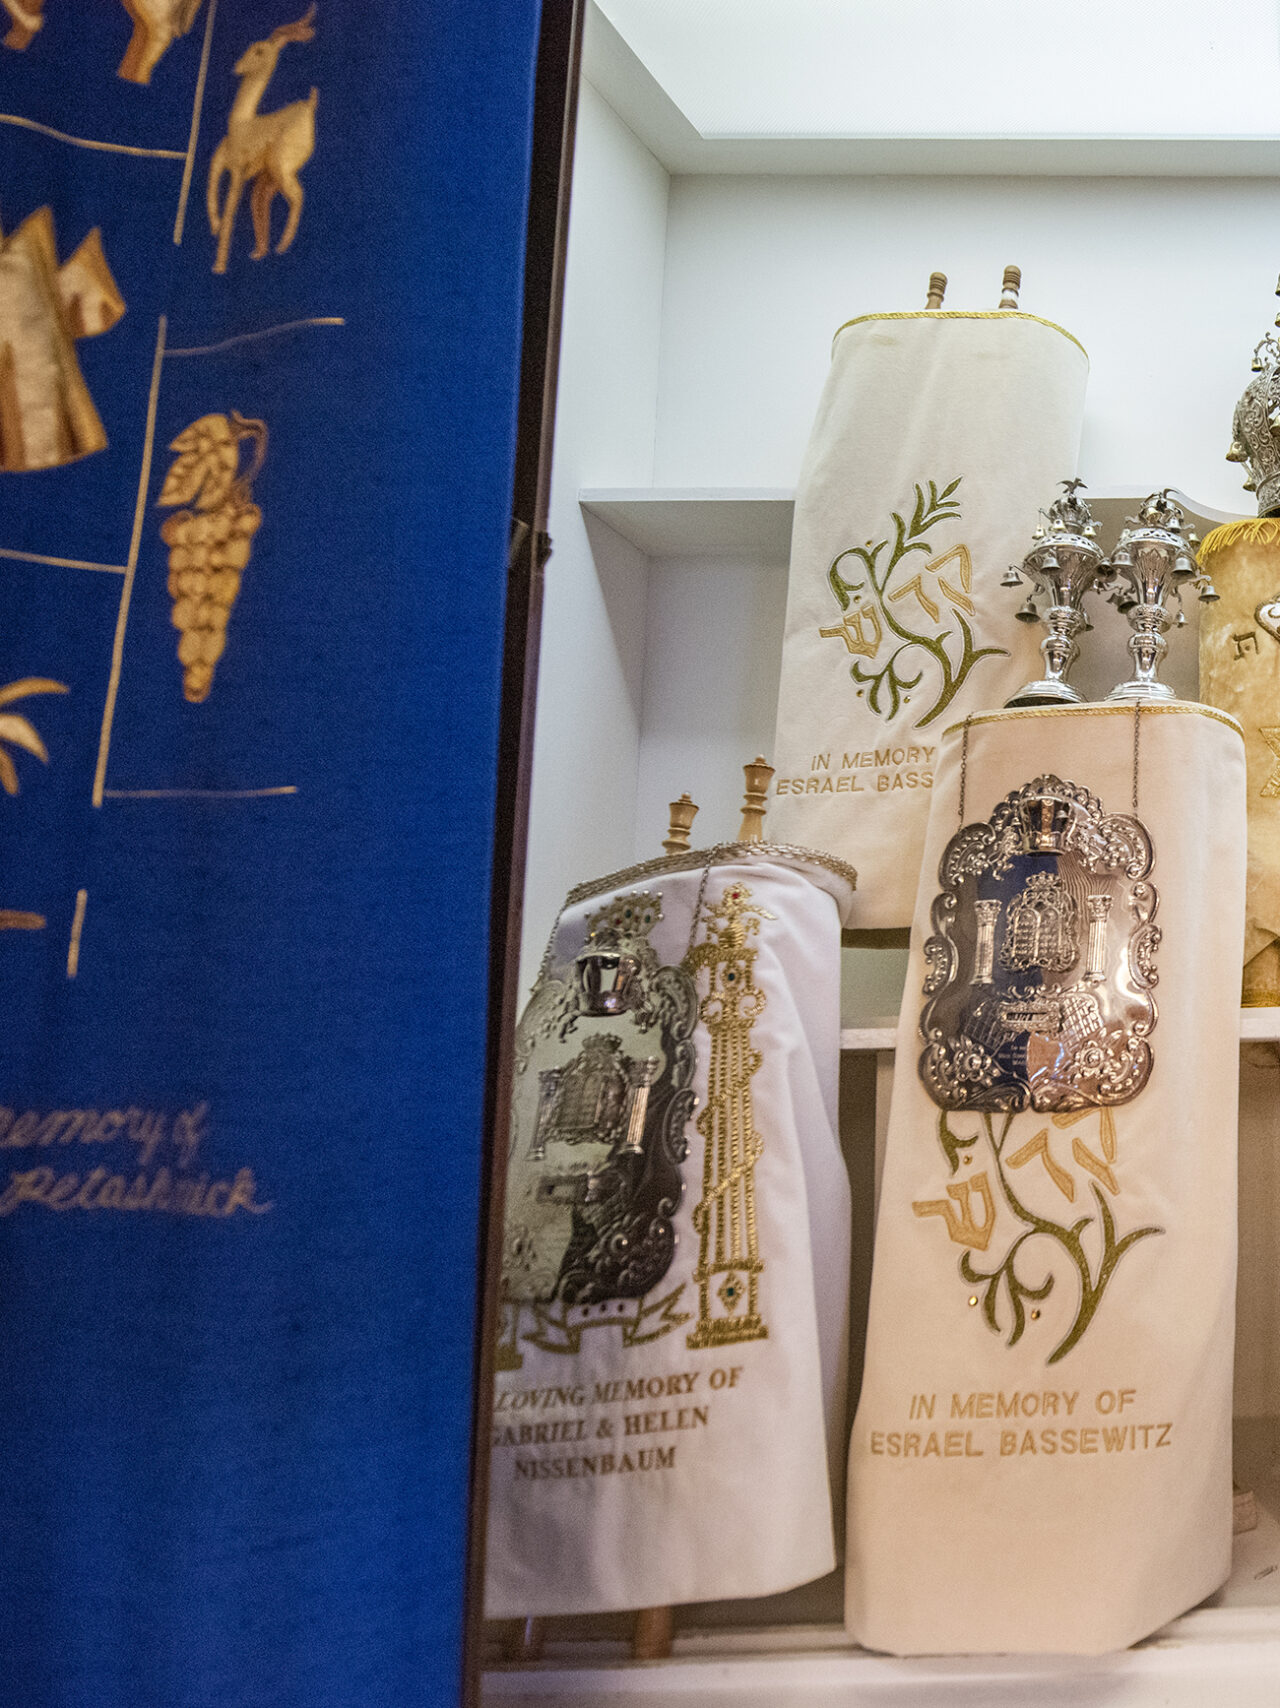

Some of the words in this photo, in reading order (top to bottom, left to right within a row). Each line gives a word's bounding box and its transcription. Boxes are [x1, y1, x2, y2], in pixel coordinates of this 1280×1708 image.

[811, 753, 831, 771] IN
[841, 746, 937, 770] MEMORY
[776, 774, 865, 796] ESRAEL
[877, 771, 934, 793] BASS
[493, 1386, 585, 1414] LOVING
[594, 1371, 700, 1404] MEMORY
[709, 1366, 744, 1391] OF
[908, 1393, 937, 1421] IN
[949, 1389, 1080, 1420] MEMORY
[1095, 1388, 1138, 1415] OF
[596, 1419, 614, 1440] &
[624, 1406, 710, 1437] HELEN
[869, 1430, 984, 1458] ESRAEL
[998, 1422, 1173, 1457] BASSEWITZ
[514, 1446, 678, 1481] NISSENBAUM
